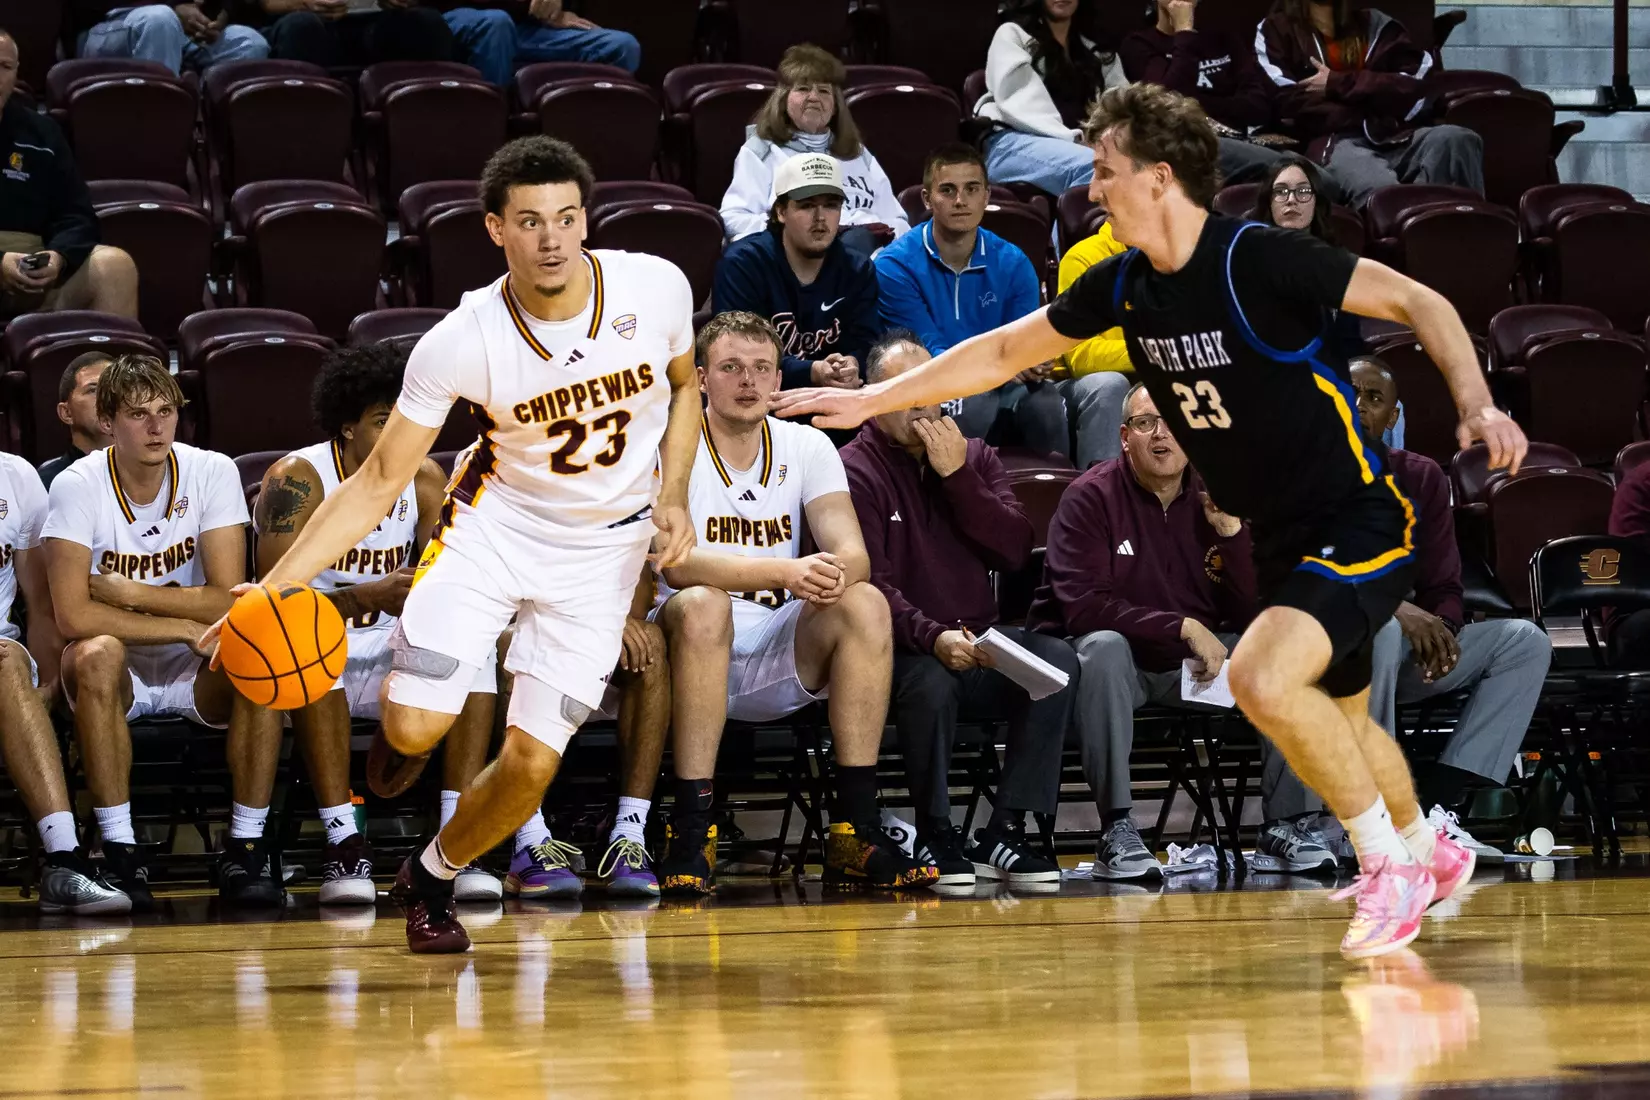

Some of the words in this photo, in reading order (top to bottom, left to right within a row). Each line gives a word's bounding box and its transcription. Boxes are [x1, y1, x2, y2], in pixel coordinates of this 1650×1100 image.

[615, 319, 636, 332] MAC
[1180, 330, 1232, 370] PARK
[512, 362, 655, 424] CHIPPEWAS
[1171, 380, 1232, 429] 23
[545, 409, 632, 475] 23
